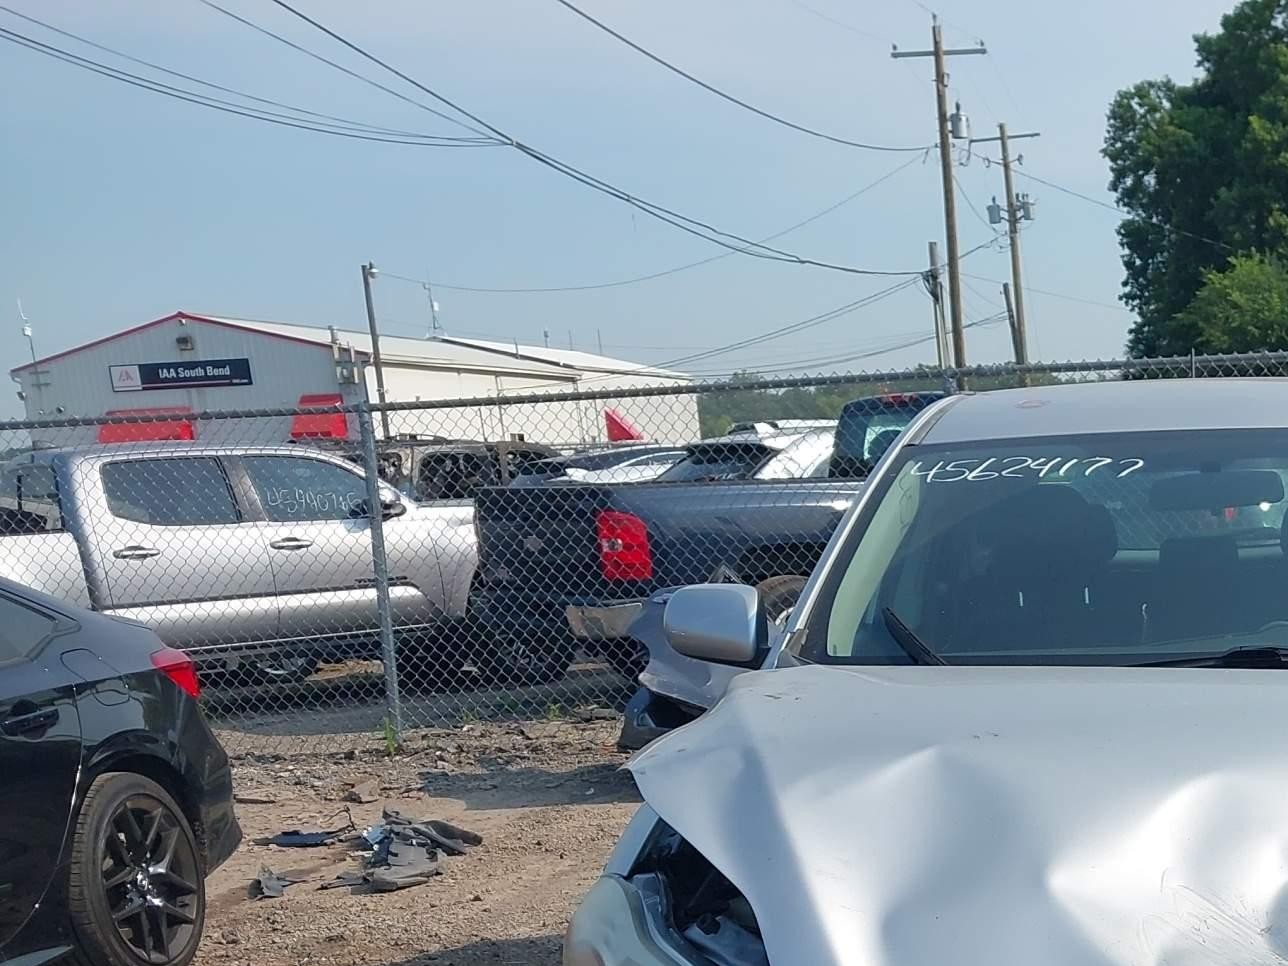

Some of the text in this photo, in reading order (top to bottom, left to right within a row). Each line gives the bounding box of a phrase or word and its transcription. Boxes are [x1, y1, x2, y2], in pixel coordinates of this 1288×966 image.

[159, 365, 231, 378] IAA South Bend
[911, 457, 1144, 483] 45624177
